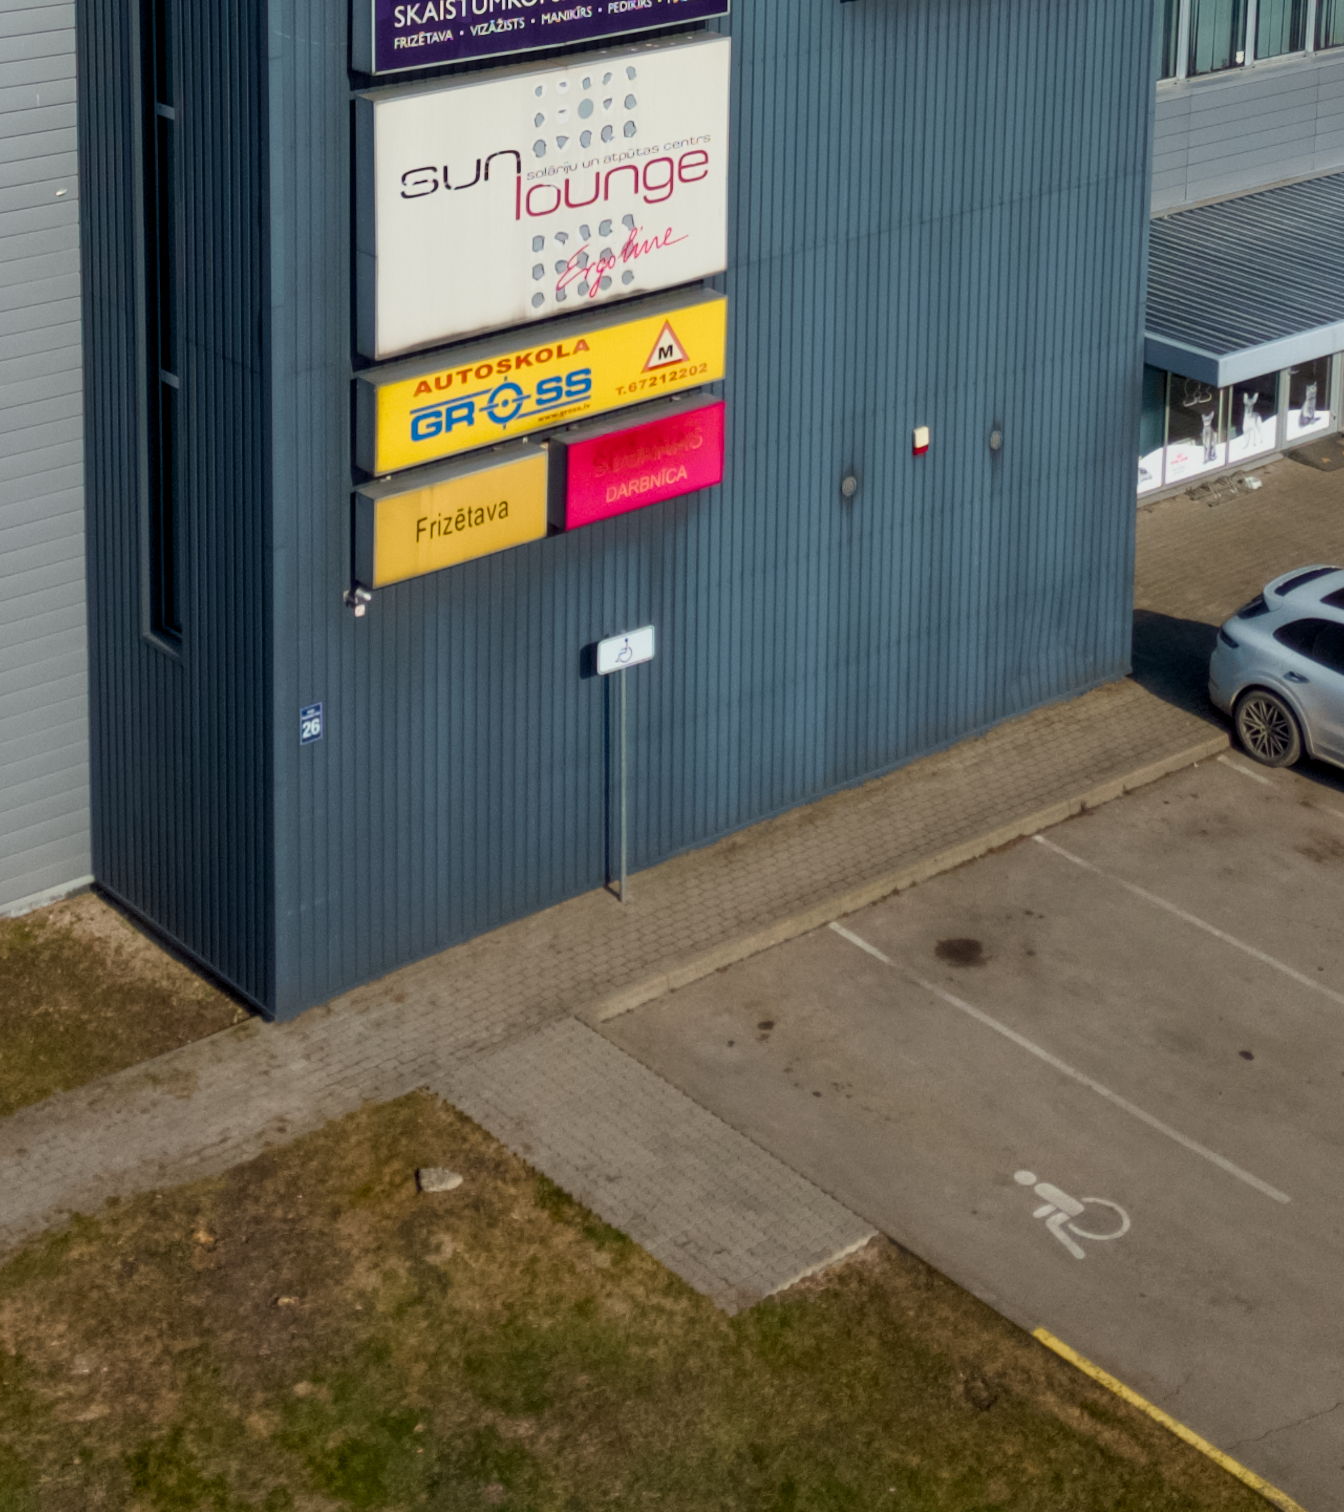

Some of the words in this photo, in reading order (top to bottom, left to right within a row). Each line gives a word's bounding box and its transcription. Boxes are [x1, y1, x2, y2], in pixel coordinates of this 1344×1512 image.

[394, 30, 453, 50] FRIZĒTAVA
[470, 16, 525, 37] VIZĀŽISTS
[541, 5, 593, 26] MANIKĪRS
[400, 149, 522, 199] sun
[526, 161, 578, 181] solāriju
[582, 158, 600, 169] un
[603, 145, 660, 165] atpūtas
[663, 134, 711, 151] centrs
[515, 149, 709, 220] lounge
[413, 338, 591, 397] AUTOSKOLA
[657, 344, 675, 361] M
[615, 362, 709, 397] T.67212202
[605, 465, 689, 504] DARBNĪCA
[416, 498, 509, 544] Frizētava
[302, 718, 320, 739] 26
